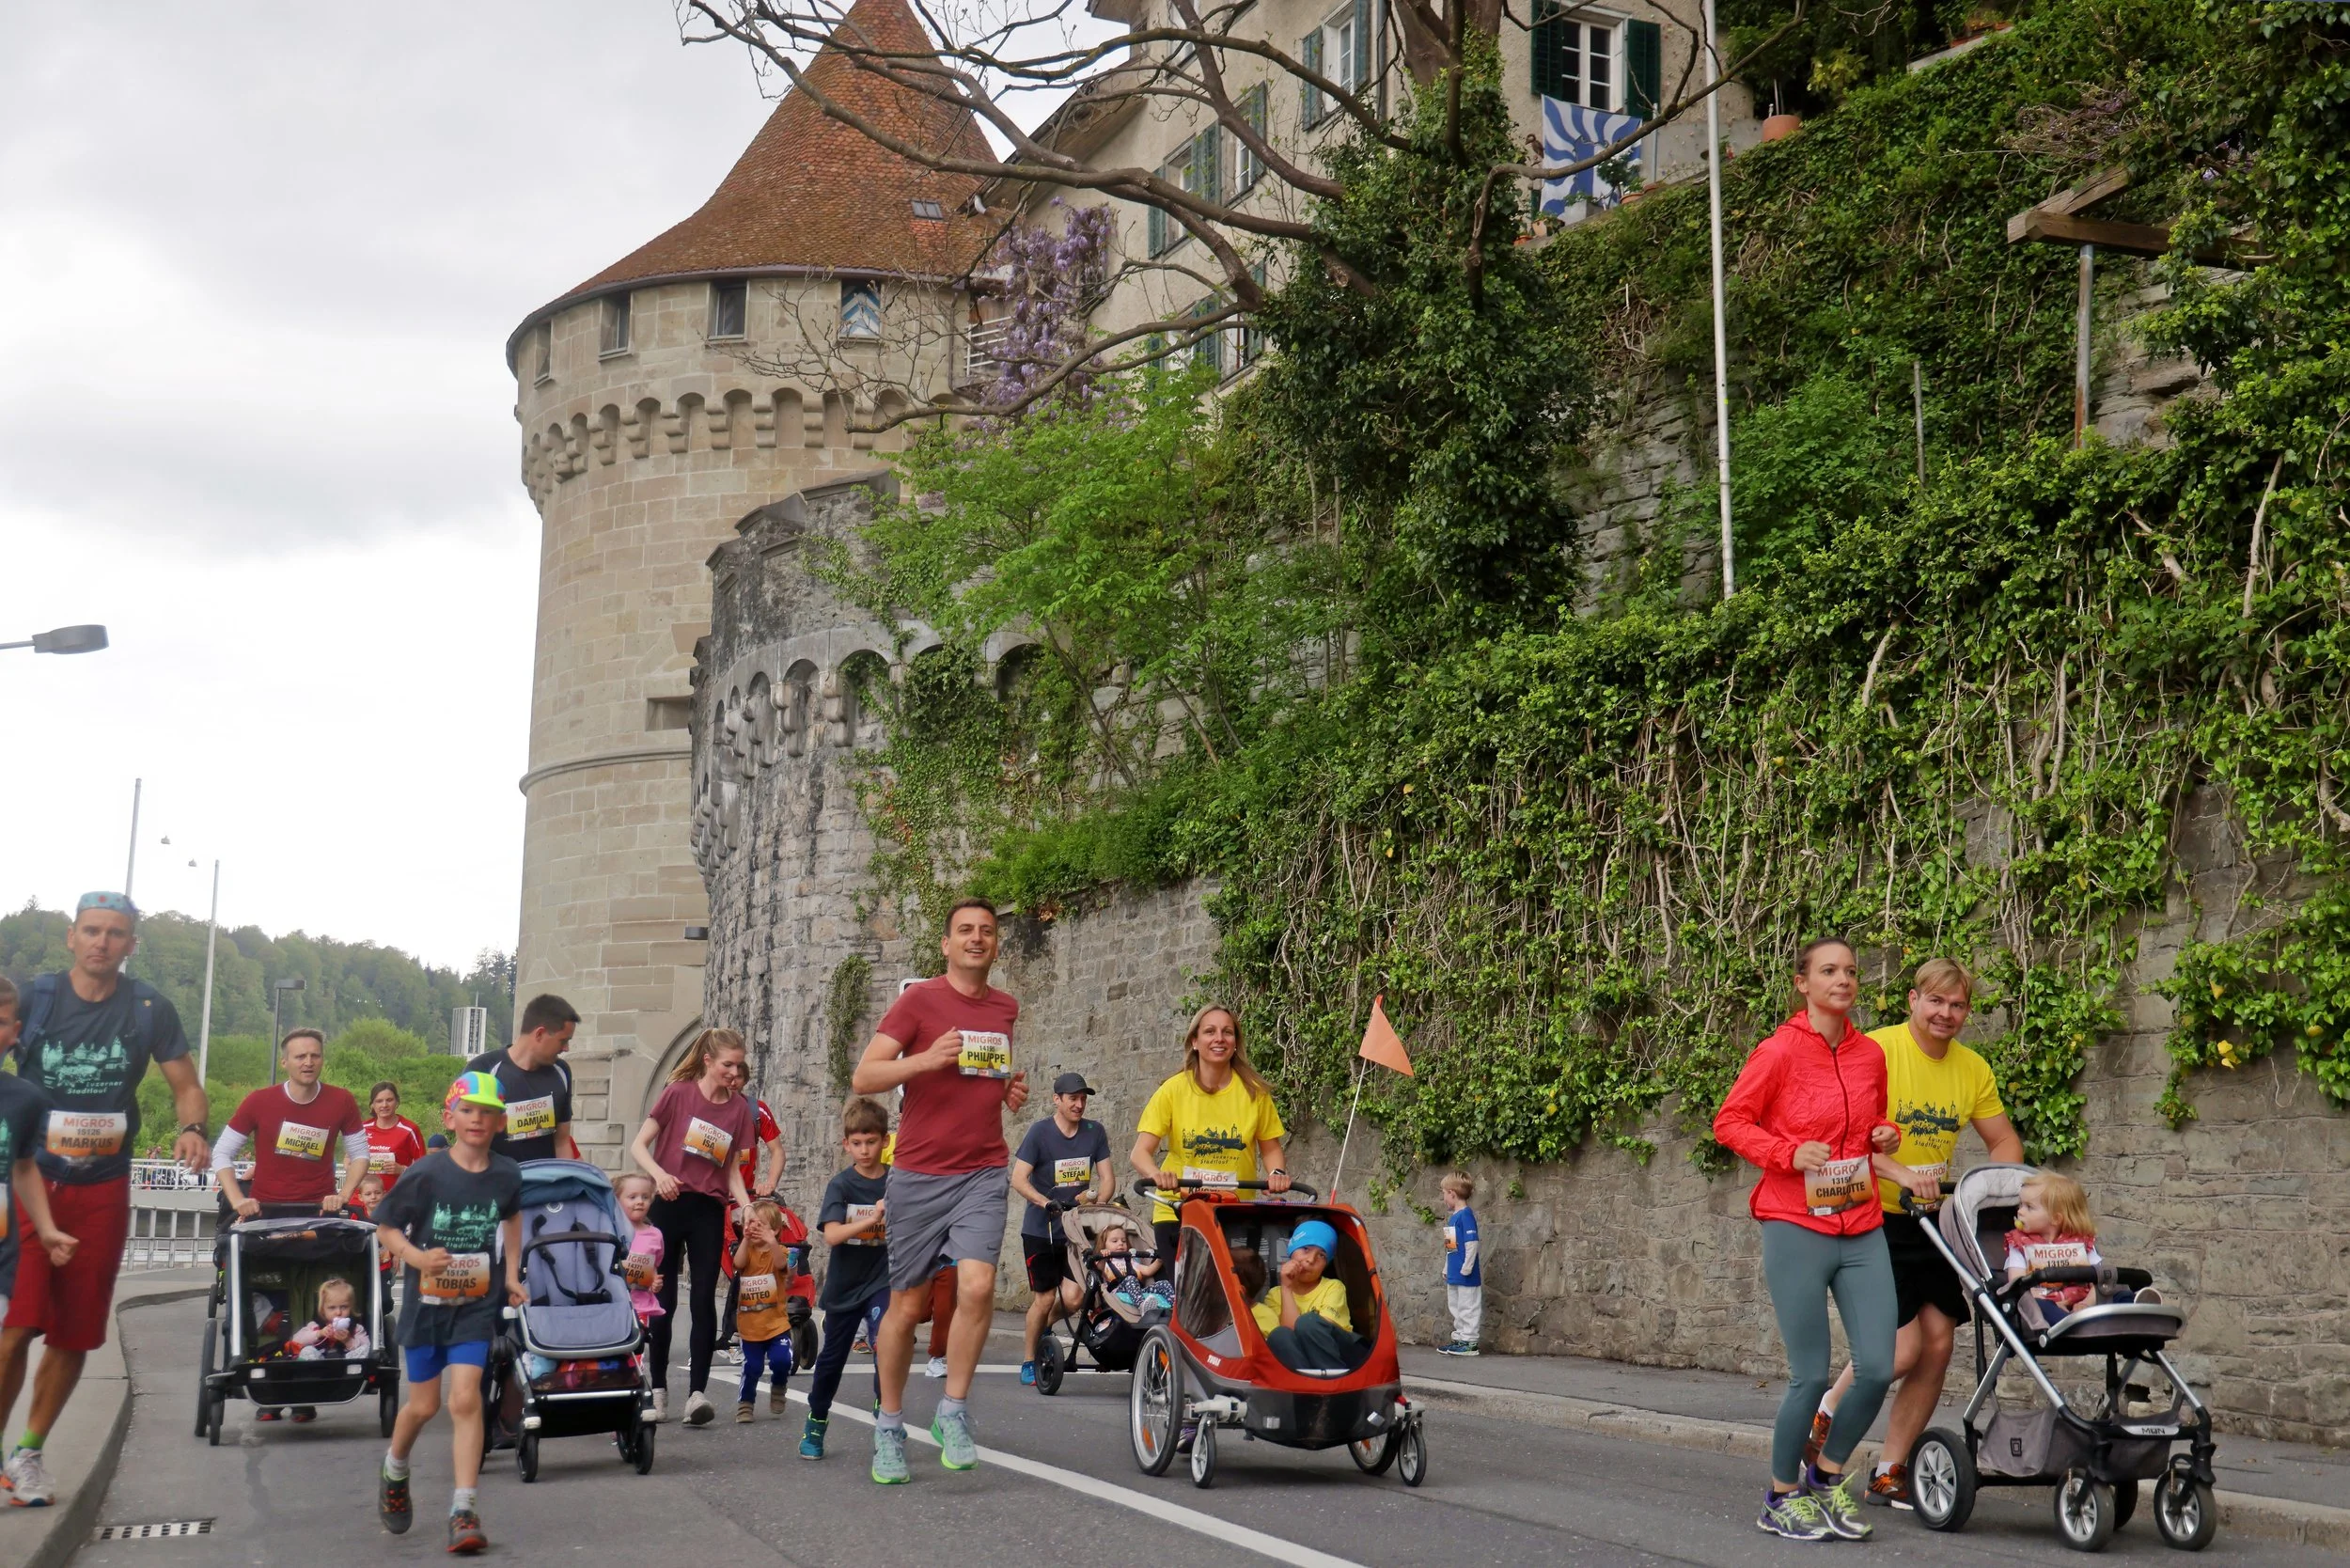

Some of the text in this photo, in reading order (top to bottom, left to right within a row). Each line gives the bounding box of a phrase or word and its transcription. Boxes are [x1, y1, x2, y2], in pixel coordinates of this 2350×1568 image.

[968, 1035, 1003, 1045] MIGROS
[967, 1051, 1006, 1064] PHILIPPE
[514, 1101, 548, 1113] MIGROS
[63, 1117, 115, 1128] MIGROS
[517, 1114, 550, 1128] DAMIAN
[290, 1126, 321, 1137] MIGROS
[698, 1123, 728, 1141] MIGROS
[61, 1137, 114, 1148] MARKUS
[285, 1137, 320, 1151] MICHAEL
[702, 1138, 715, 1150] ISA
[1062, 1170, 1086, 1179] STEFAN
[1192, 1171, 1229, 1183] MIGROS
[1815, 1181, 1866, 1198] CHARLOTTE
[2034, 1248, 2079, 1259] MIGROS
[435, 1278, 478, 1290] TOBIAS
[741, 1291, 770, 1301] MATTEO
